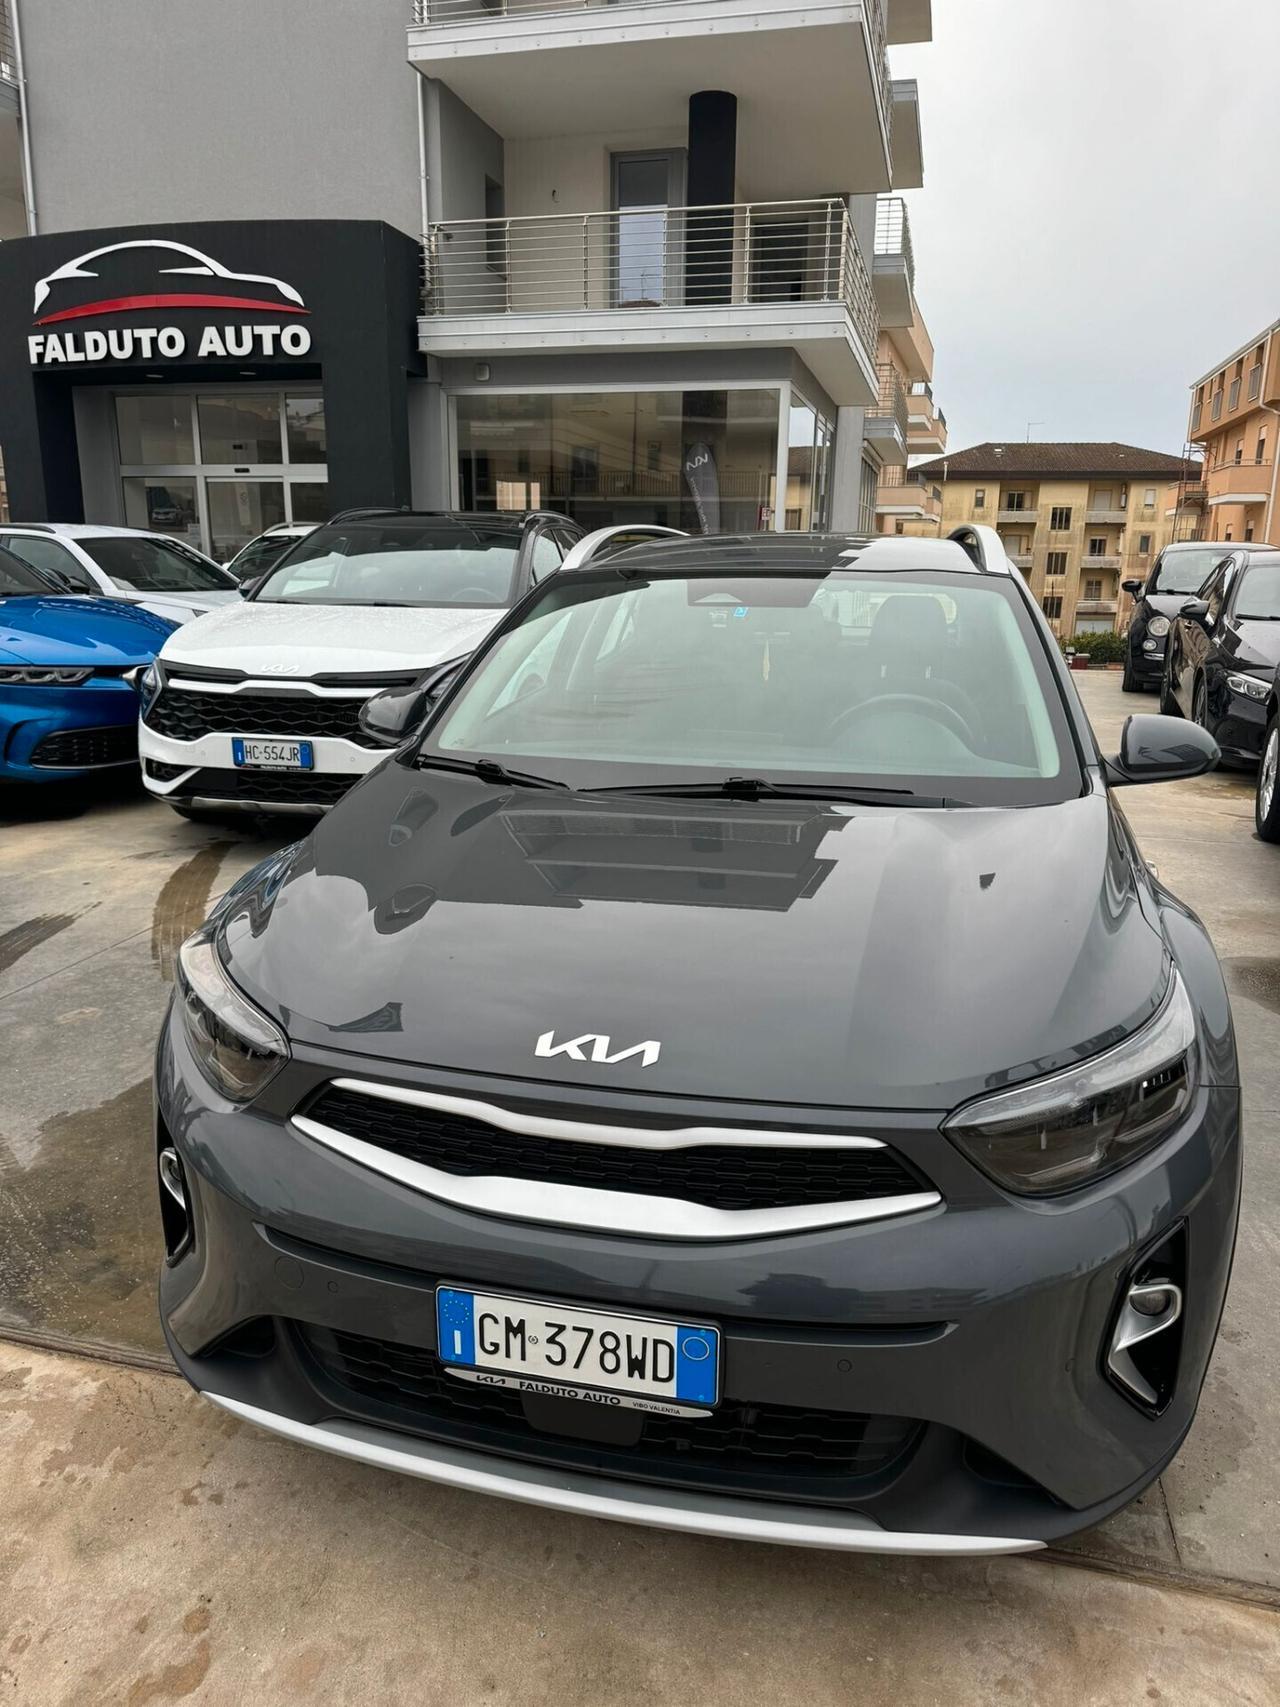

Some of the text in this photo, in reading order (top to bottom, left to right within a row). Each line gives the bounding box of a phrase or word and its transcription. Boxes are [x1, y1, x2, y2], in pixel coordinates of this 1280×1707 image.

[27, 324, 311, 365] FALDUTO AUTO
[534, 1030, 662, 1068] KIA
[476, 1374, 681, 1416] KIA FALDUTO AUTO VIBO VALENTIA
